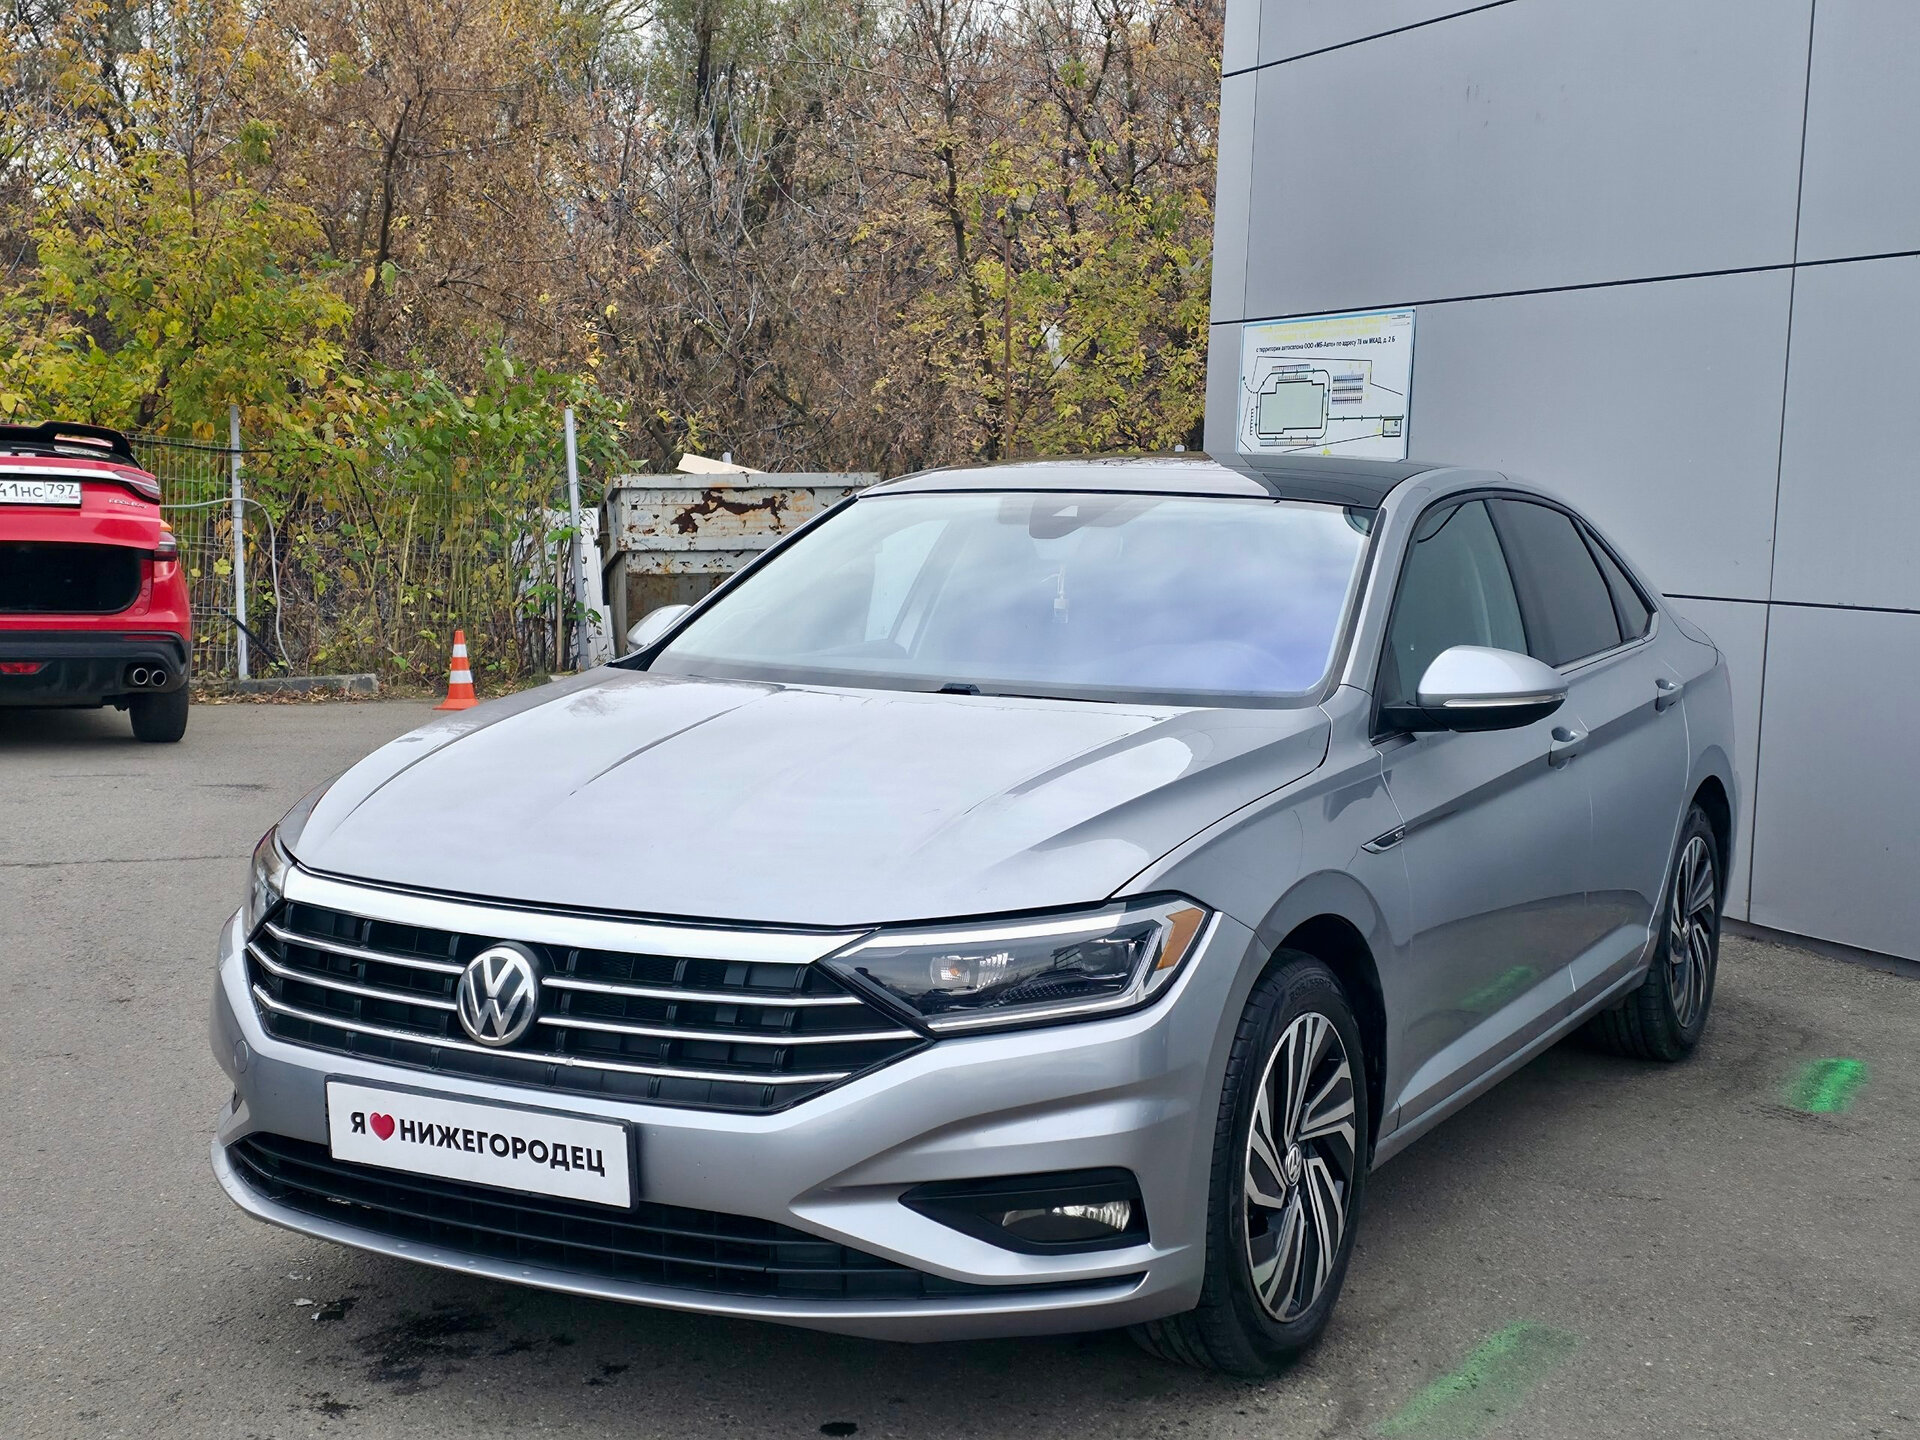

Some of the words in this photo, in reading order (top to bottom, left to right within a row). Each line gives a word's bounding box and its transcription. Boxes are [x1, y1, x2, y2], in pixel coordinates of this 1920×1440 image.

[47, 484, 74, 495] 797
[350, 1111, 366, 1135] Я
[399, 1118, 606, 1178] НИЖЕГОРОДЕЦ
